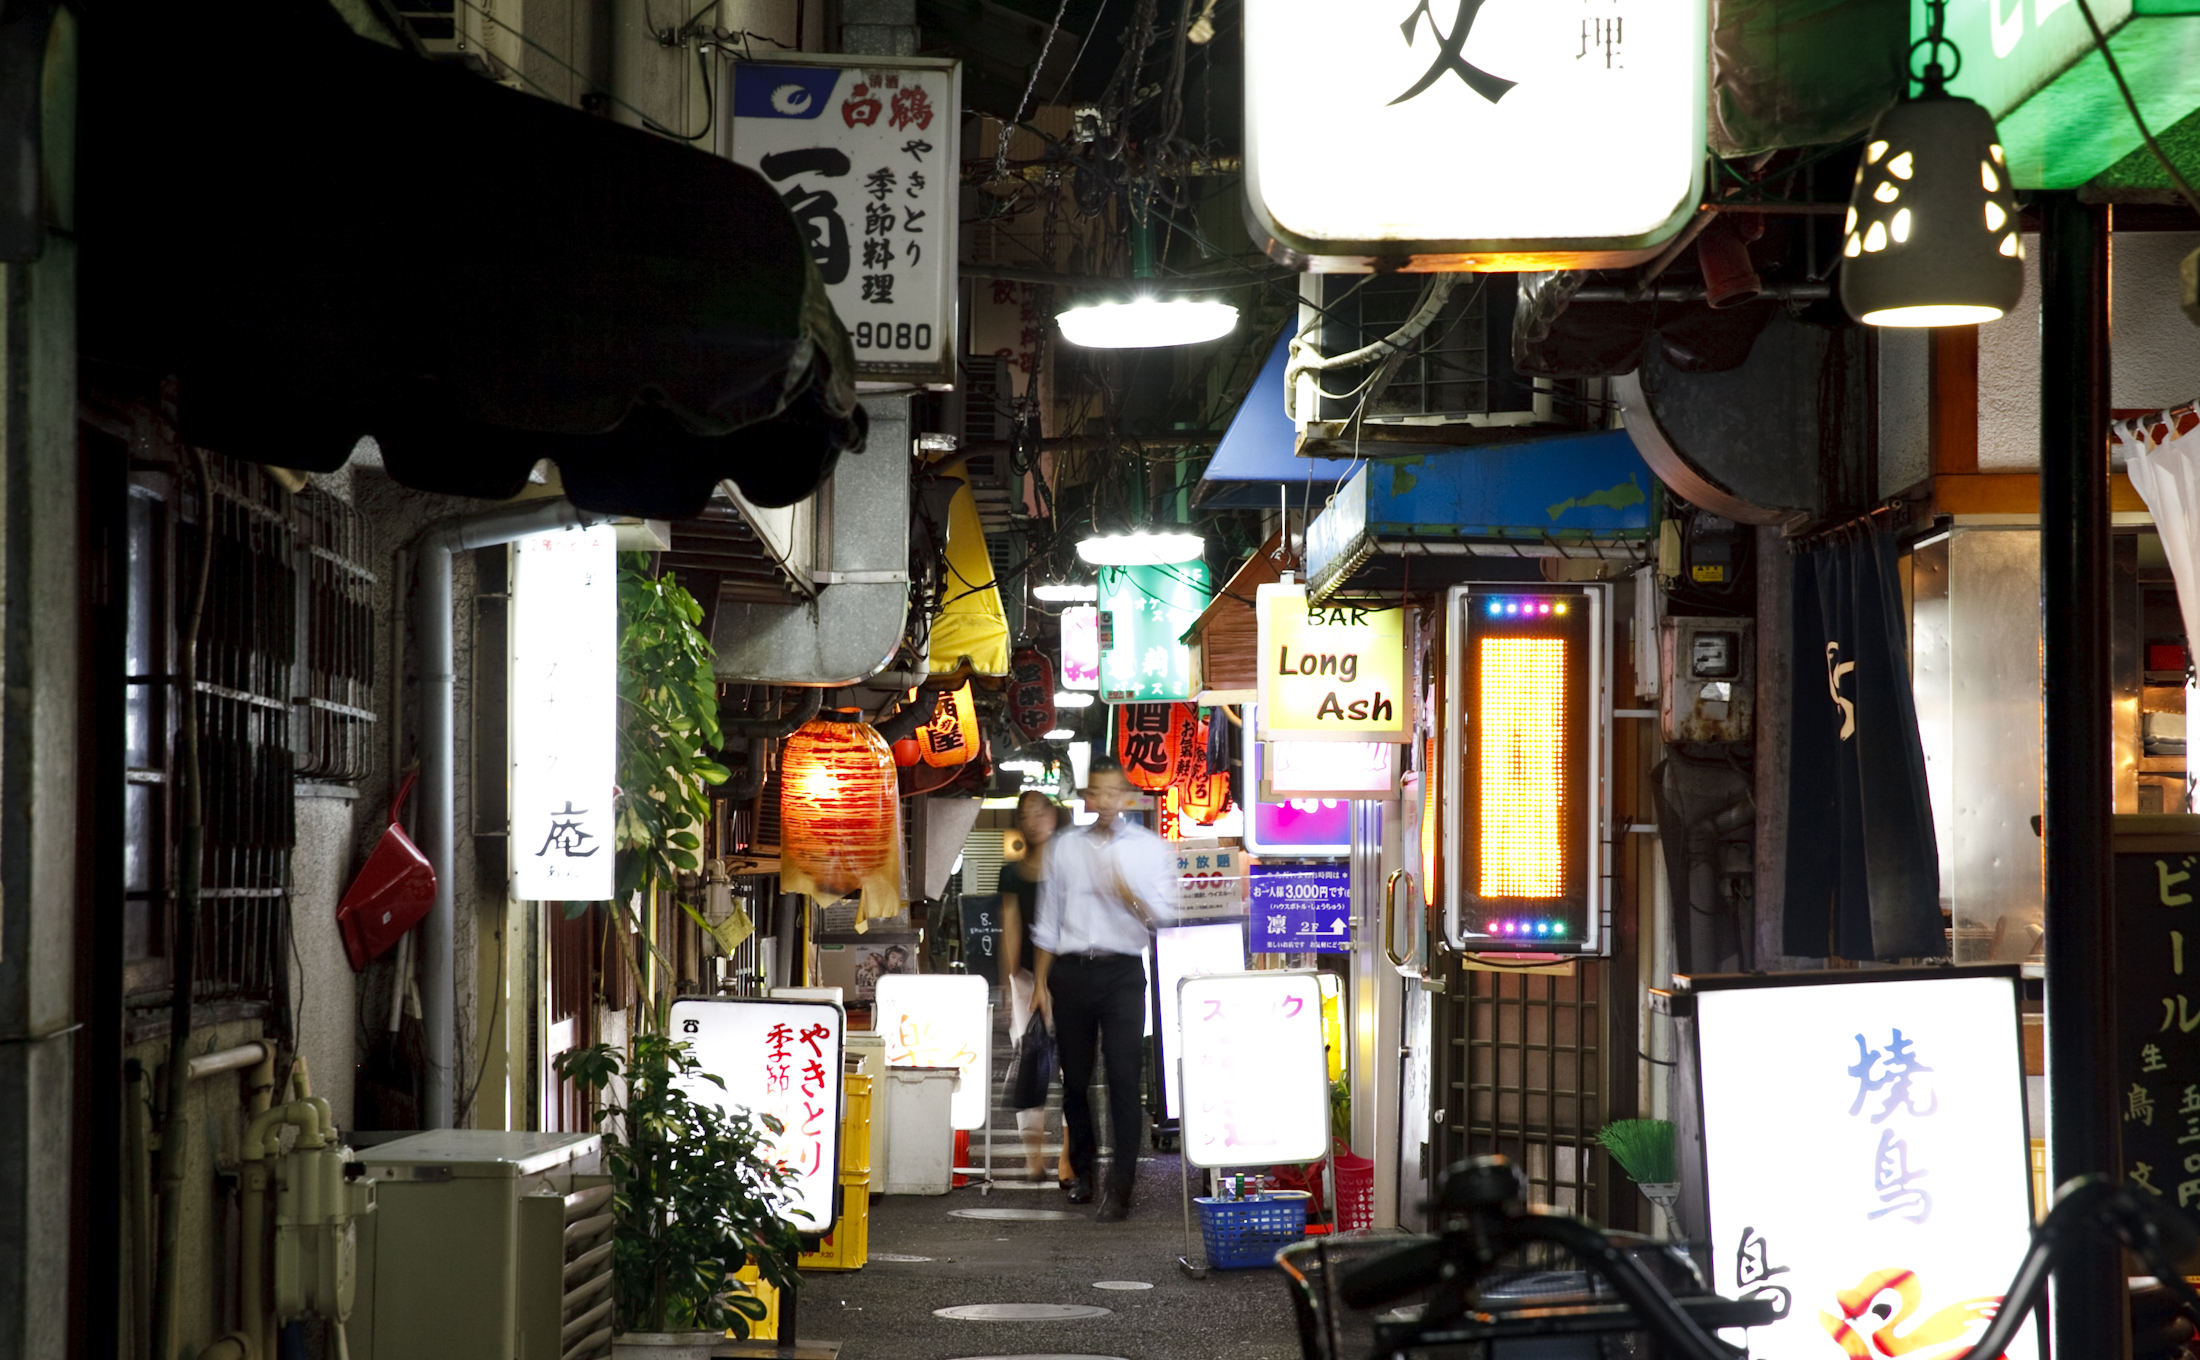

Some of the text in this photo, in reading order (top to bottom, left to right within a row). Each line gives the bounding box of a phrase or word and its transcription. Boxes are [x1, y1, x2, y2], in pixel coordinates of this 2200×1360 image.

[868, 74, 899, 90] 清酒
[841, 83, 934, 131] 白鶴
[901, 138, 934, 268] やきとり
[861, 166, 897, 305] 季節料理
[1307, 607, 1369, 627] BAR
[1279, 645, 1358, 683] Long
[542, 662, 562, 774] スナク
[1015, 663, 1049, 729] 営業中
[1316, 691, 1393, 721] Ash
[535, 800, 600, 858] 庵
[1300, 921, 1320, 932] 2F
[2154, 855, 2200, 1034] ビール
[1203, 995, 1304, 1022] スック
[2140, 1044, 2168, 1073] 生
[799, 1022, 831, 1179] やきとり
